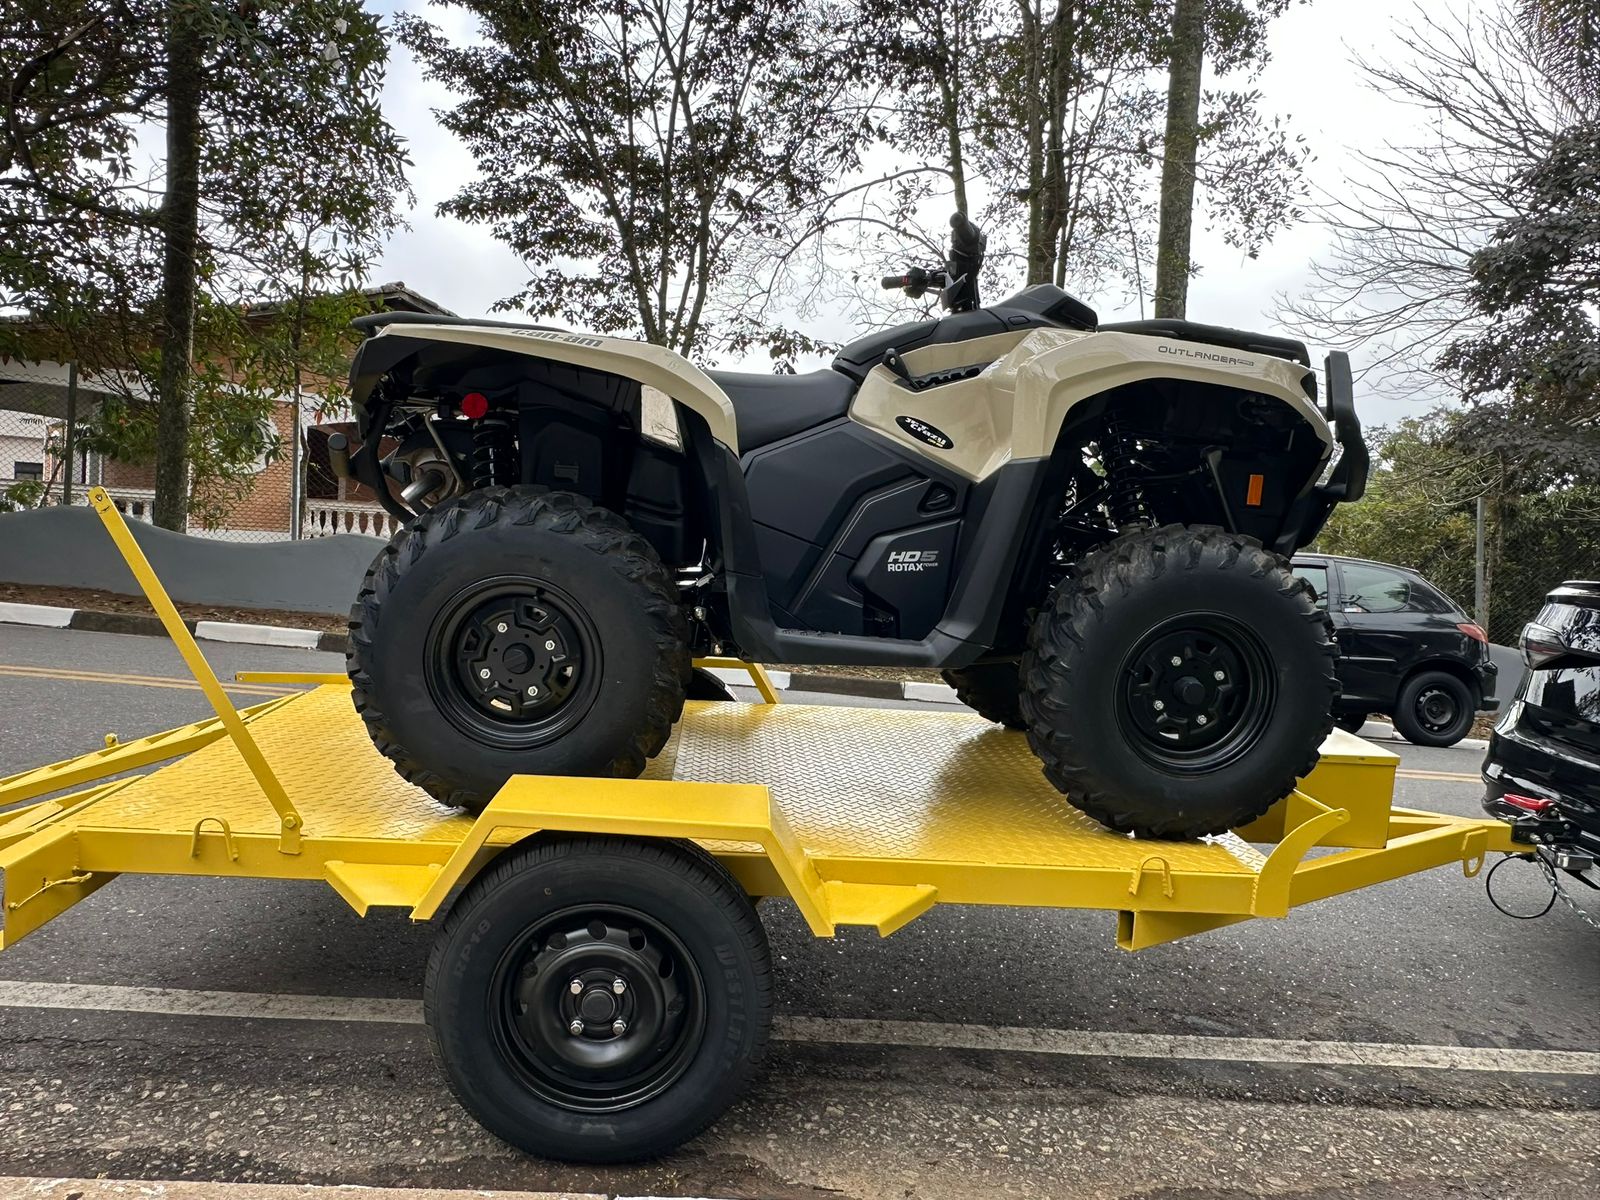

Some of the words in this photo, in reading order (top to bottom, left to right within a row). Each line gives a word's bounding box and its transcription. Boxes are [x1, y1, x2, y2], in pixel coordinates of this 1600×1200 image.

[1157, 345, 1237, 365] OUTLANDER
[887, 562, 924, 572] ROTAX
[712, 944, 745, 1070] WESTLA
